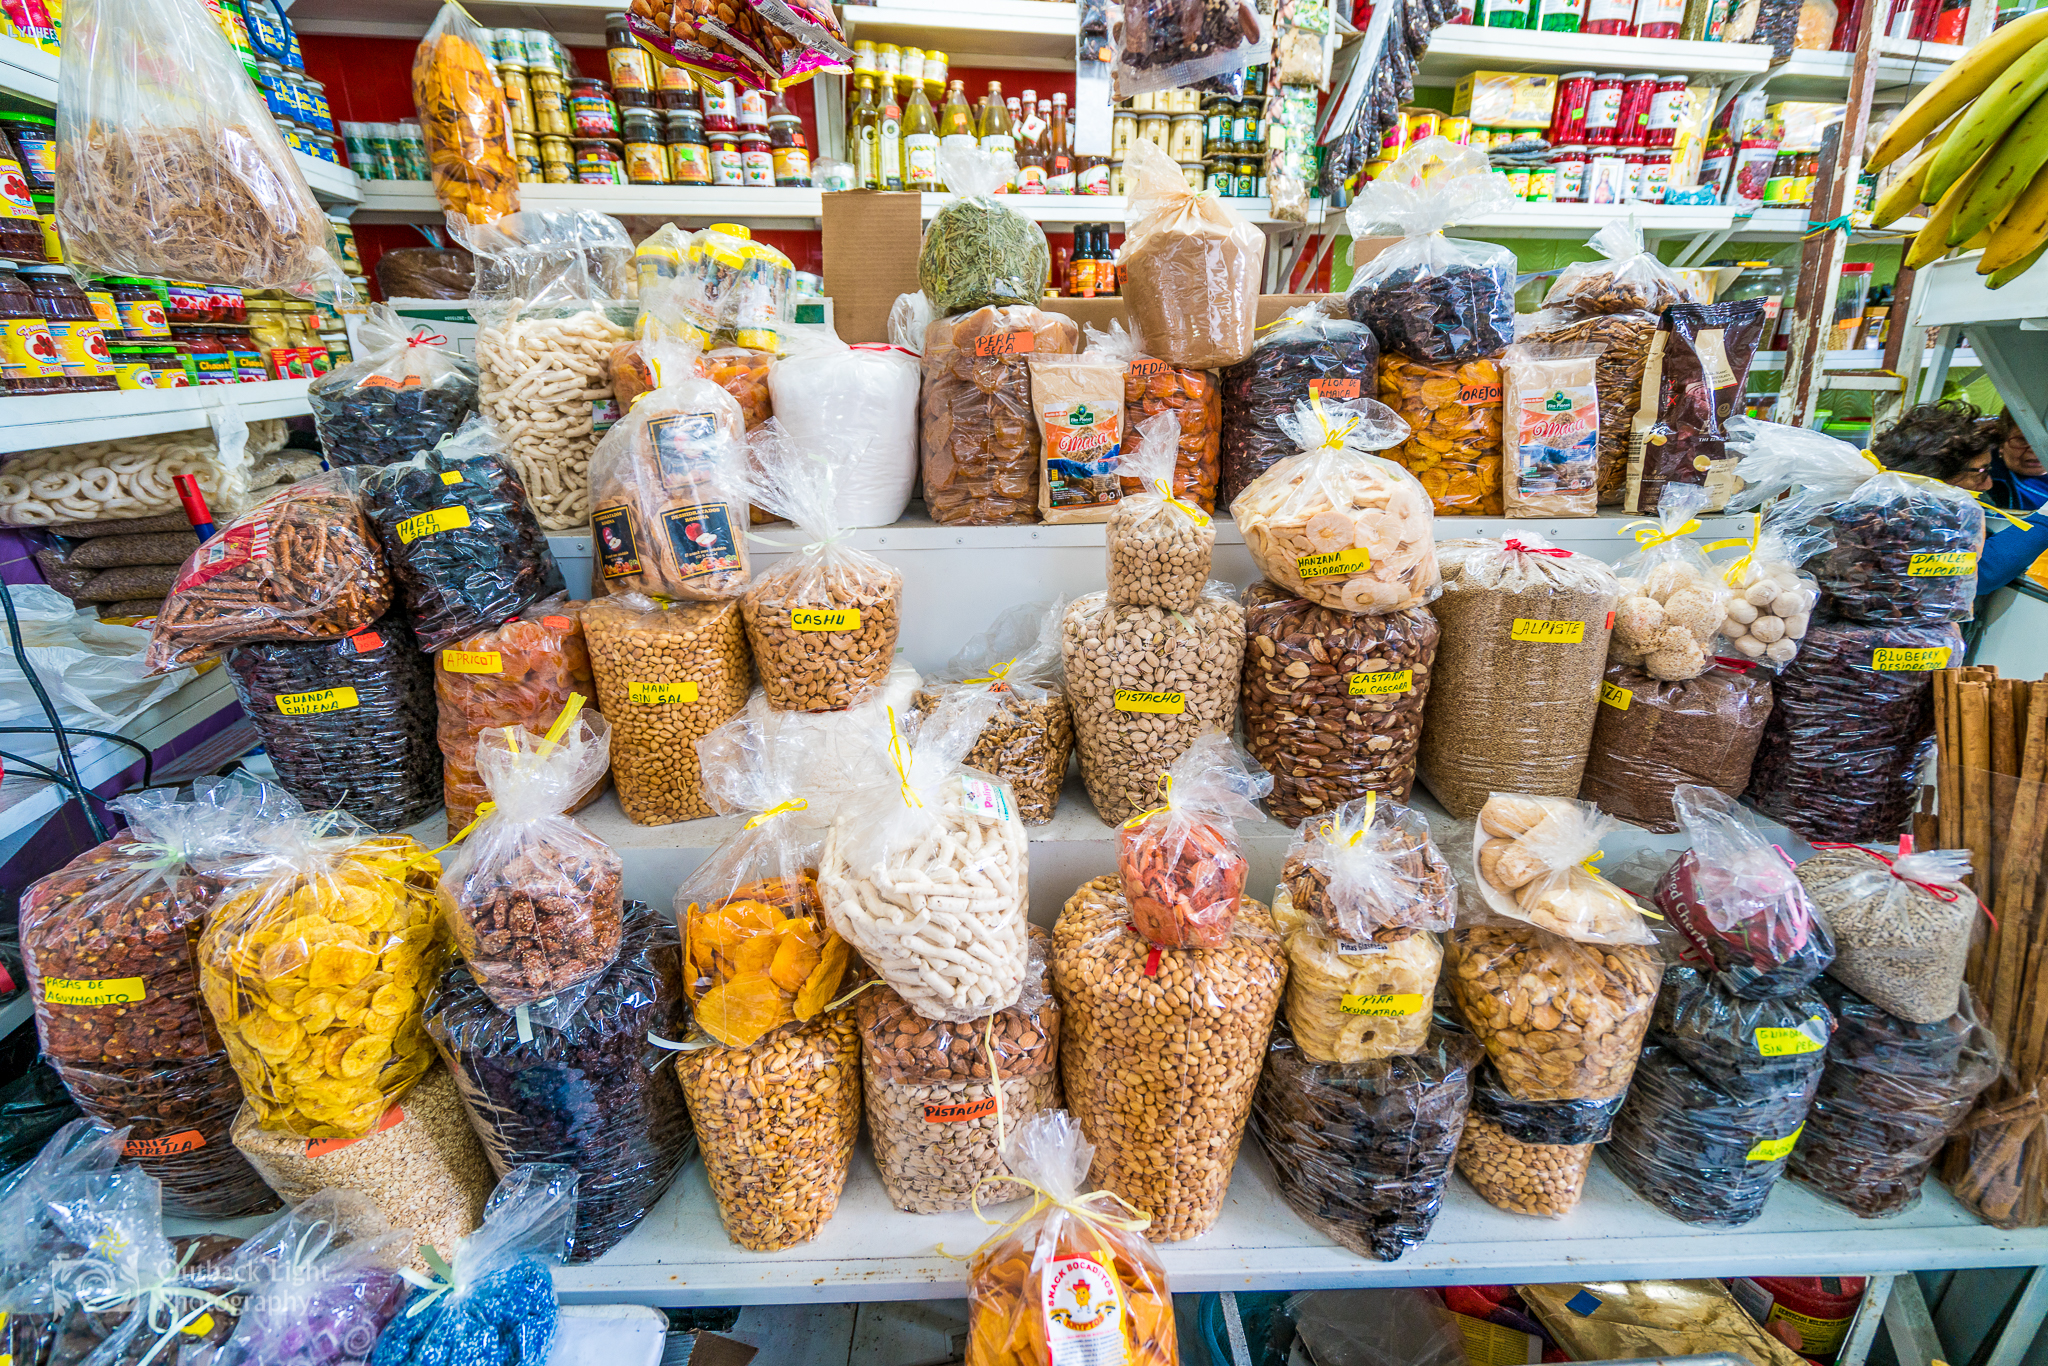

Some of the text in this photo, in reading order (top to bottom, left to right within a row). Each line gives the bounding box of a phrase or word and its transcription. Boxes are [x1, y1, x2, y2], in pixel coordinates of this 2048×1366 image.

[976, 333, 1016, 348] PERA
[984, 343, 1014, 355] SECA
[1322, 379, 1343, 388] FLOR
[1318, 389, 1350, 398] AMAICA
[1533, 419, 1585, 438] Maca
[1059, 432, 1108, 452] Maca
[401, 513, 434, 537] HIGO
[1297, 552, 1341, 567] MANZANA
[1912, 553, 1967, 564] DATILES
[793, 613, 845, 625] CASHU
[1513, 621, 1580, 636] ALPISTE
[447, 652, 499, 667] APRICOT
[1875, 649, 1939, 662] BLUBERRY
[1370, 682, 1408, 693] CASCARA
[282, 690, 334, 704] GUINDA
[658, 694, 682, 704] SAL
[1116, 690, 1181, 703] PISTACHO
[287, 700, 339, 714] CHILENA
[1669, 863, 1684, 900] Dried
[46, 977, 104, 989] PASAS DE
[1763, 1044, 1782, 1053] SIN
[126, 1137, 173, 1150] ANIZ
[1066, 1261, 1114, 1296] BOCADITOS
[1065, 1315, 1105, 1330] KRYPTOS
